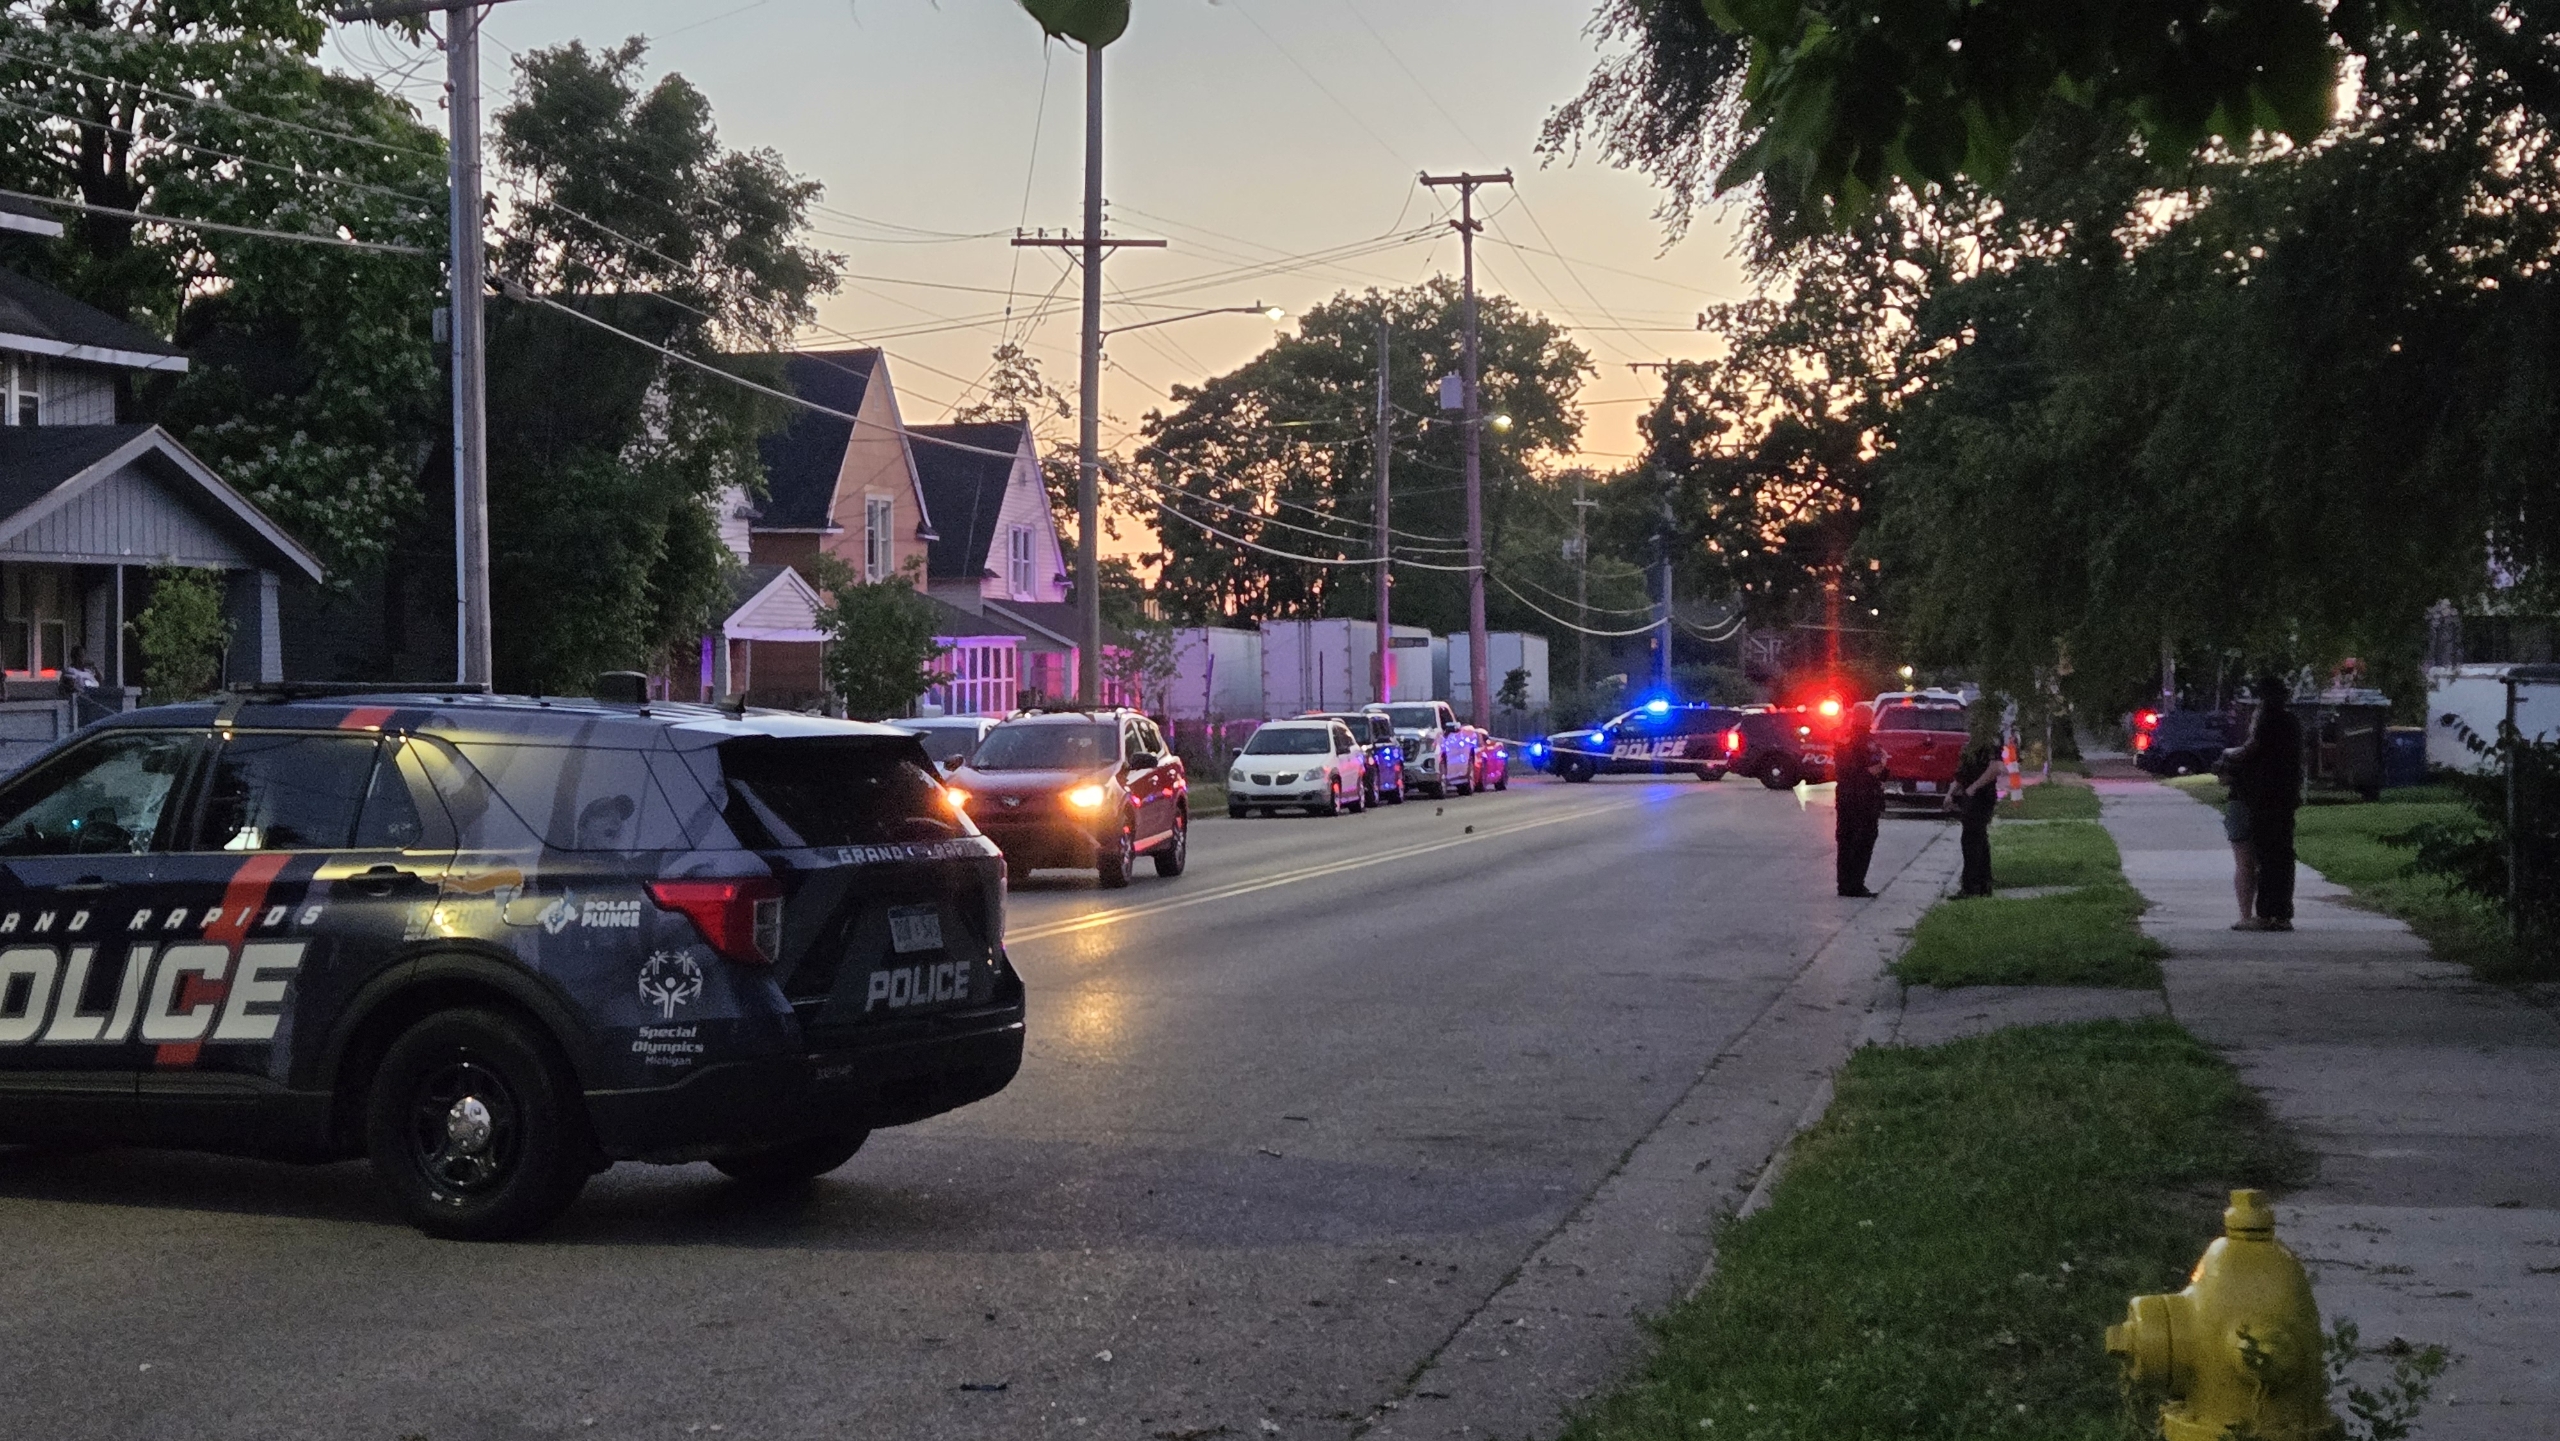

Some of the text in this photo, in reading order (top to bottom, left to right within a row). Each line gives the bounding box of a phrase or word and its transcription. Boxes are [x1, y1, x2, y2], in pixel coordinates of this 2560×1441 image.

[1611, 740, 1688, 761] POLICE
[1801, 752, 1836, 765] POL
[837, 848, 904, 864] GRAND
[584, 901, 641, 911] POLAR
[0, 905, 323, 933] AND RAPIDS
[581, 911, 640, 927] PLUNGE
[0, 945, 306, 1041] OLICE
[864, 961, 971, 1013] POLICE
[638, 1026, 698, 1039] Special
[631, 1041, 704, 1055] Olympics
[645, 1055, 692, 1067] Michigan
